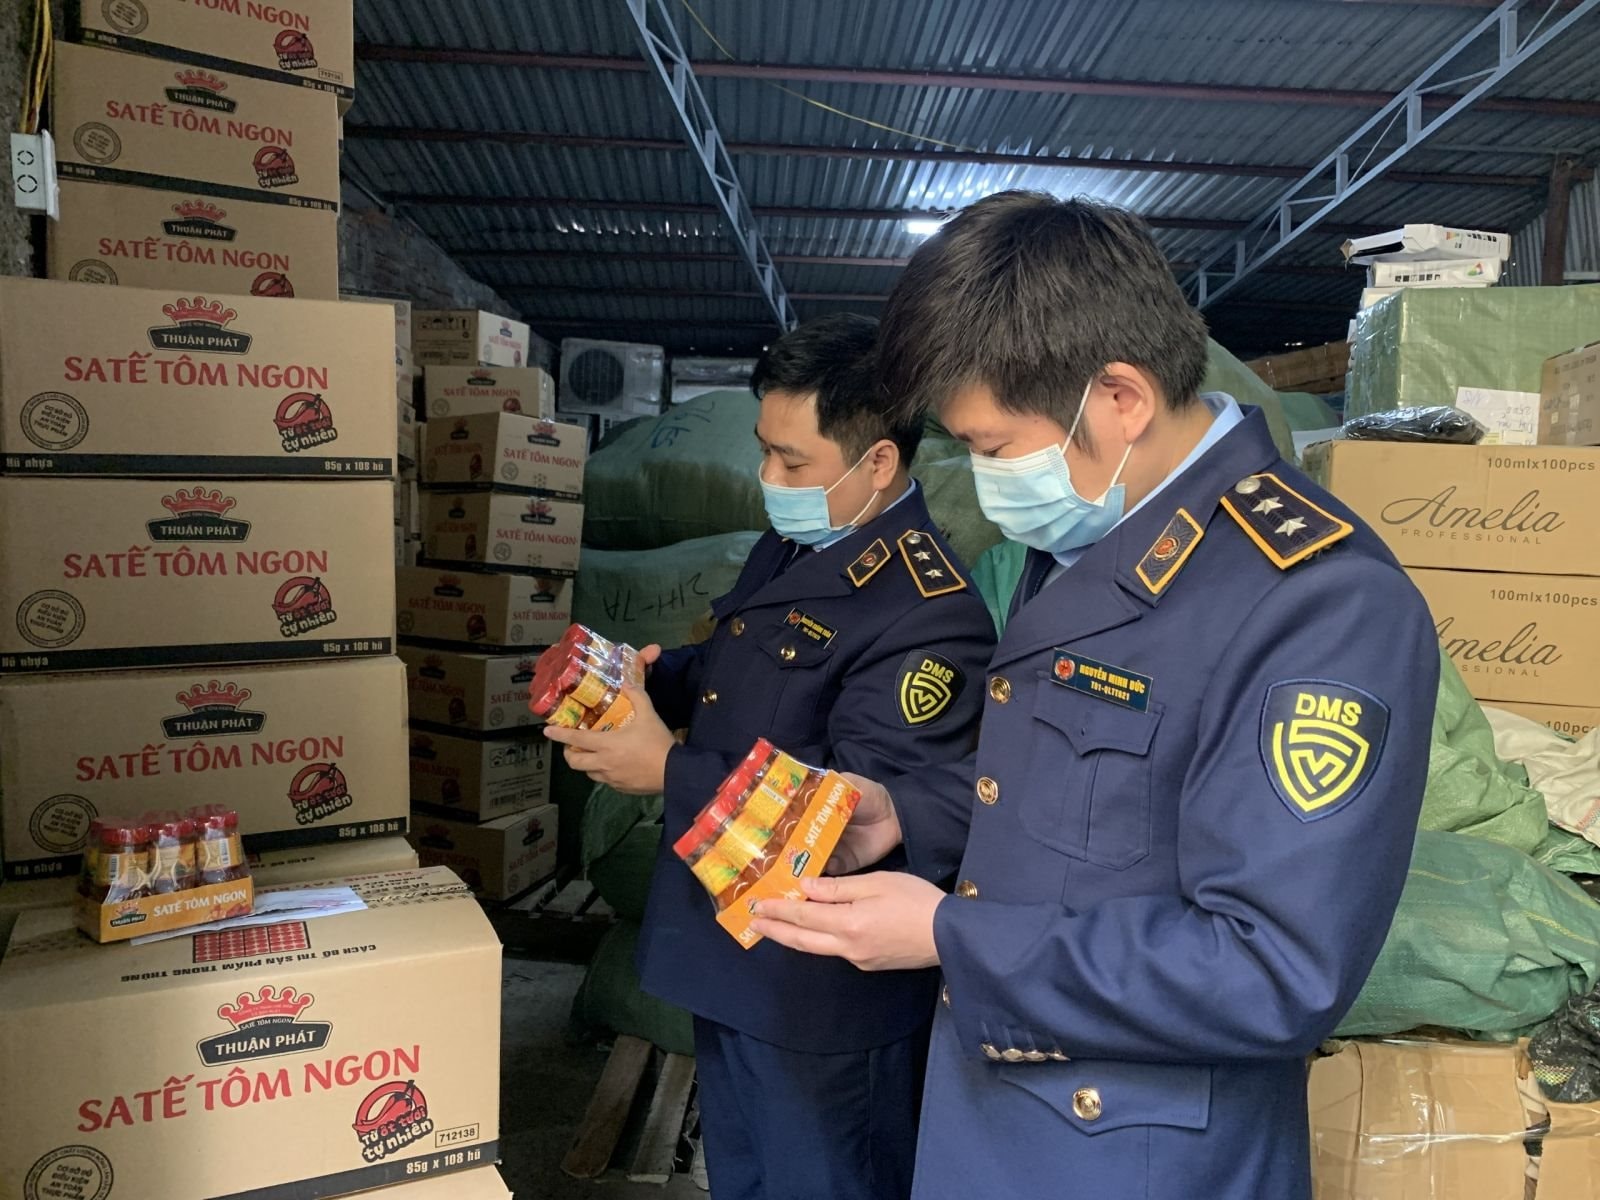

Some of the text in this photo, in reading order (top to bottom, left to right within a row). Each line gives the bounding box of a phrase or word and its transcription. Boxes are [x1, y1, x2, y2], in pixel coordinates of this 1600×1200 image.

[247, 1, 309, 31] NGON
[106, 100, 292, 146] SATẾ TÔM NGON
[98, 236, 289, 271] SATẾ TÔM NGON
[162, 333, 240, 348] THUẬN PHÁT
[64, 350, 329, 390] SATẾ TÔM NGON
[283, 428, 336, 451] tự nhiên
[324, 460, 342, 472] 85g
[345, 463, 351, 471] x
[552, 456, 579, 468] NGON
[1487, 458, 1595, 473] 100mlx100pcs
[1380, 486, 1566, 533] Amelia
[160, 523, 239, 538] THUẬN PHÁT
[547, 534, 577, 545] NGON
[1401, 529, 1541, 545] PROFESSIONAL
[63, 545, 329, 579] SATẾ TÔM NGON
[1490, 589, 1598, 607] 100mlx100pcs
[281, 611, 335, 636] tự nhiên
[323, 642, 341, 653] 85g
[921, 659, 954, 684] DMS
[1108, 673, 1128, 689] MINH
[1462, 664, 1540, 678] SSIONAL
[1295, 693, 1363, 727] DMS
[175, 715, 254, 733] THUẬN PHÁT
[76, 736, 344, 782] SATẾ TÔM NGON
[826, 782, 846, 807] NGON
[297, 795, 351, 824] tự nhiên
[338, 827, 357, 838] 85g
[360, 826, 366, 835] x
[213, 889, 247, 905] NGON
[343, 944, 377, 957] CÁCH
[173, 965, 217, 976] TRONG
[222, 958, 262, 971] PHẨM
[215, 1029, 317, 1056] THUẬN PHÁT
[77, 1045, 421, 1133] SATẾ TÔM NGON
[362, 1131, 378, 1145] Từ
[399, 1106, 426, 1127] tươi
[439, 1128, 475, 1143] 712138
[364, 1120, 432, 1160] tự nhiên
[406, 1149, 481, 1174] 85g x 108 hũ
